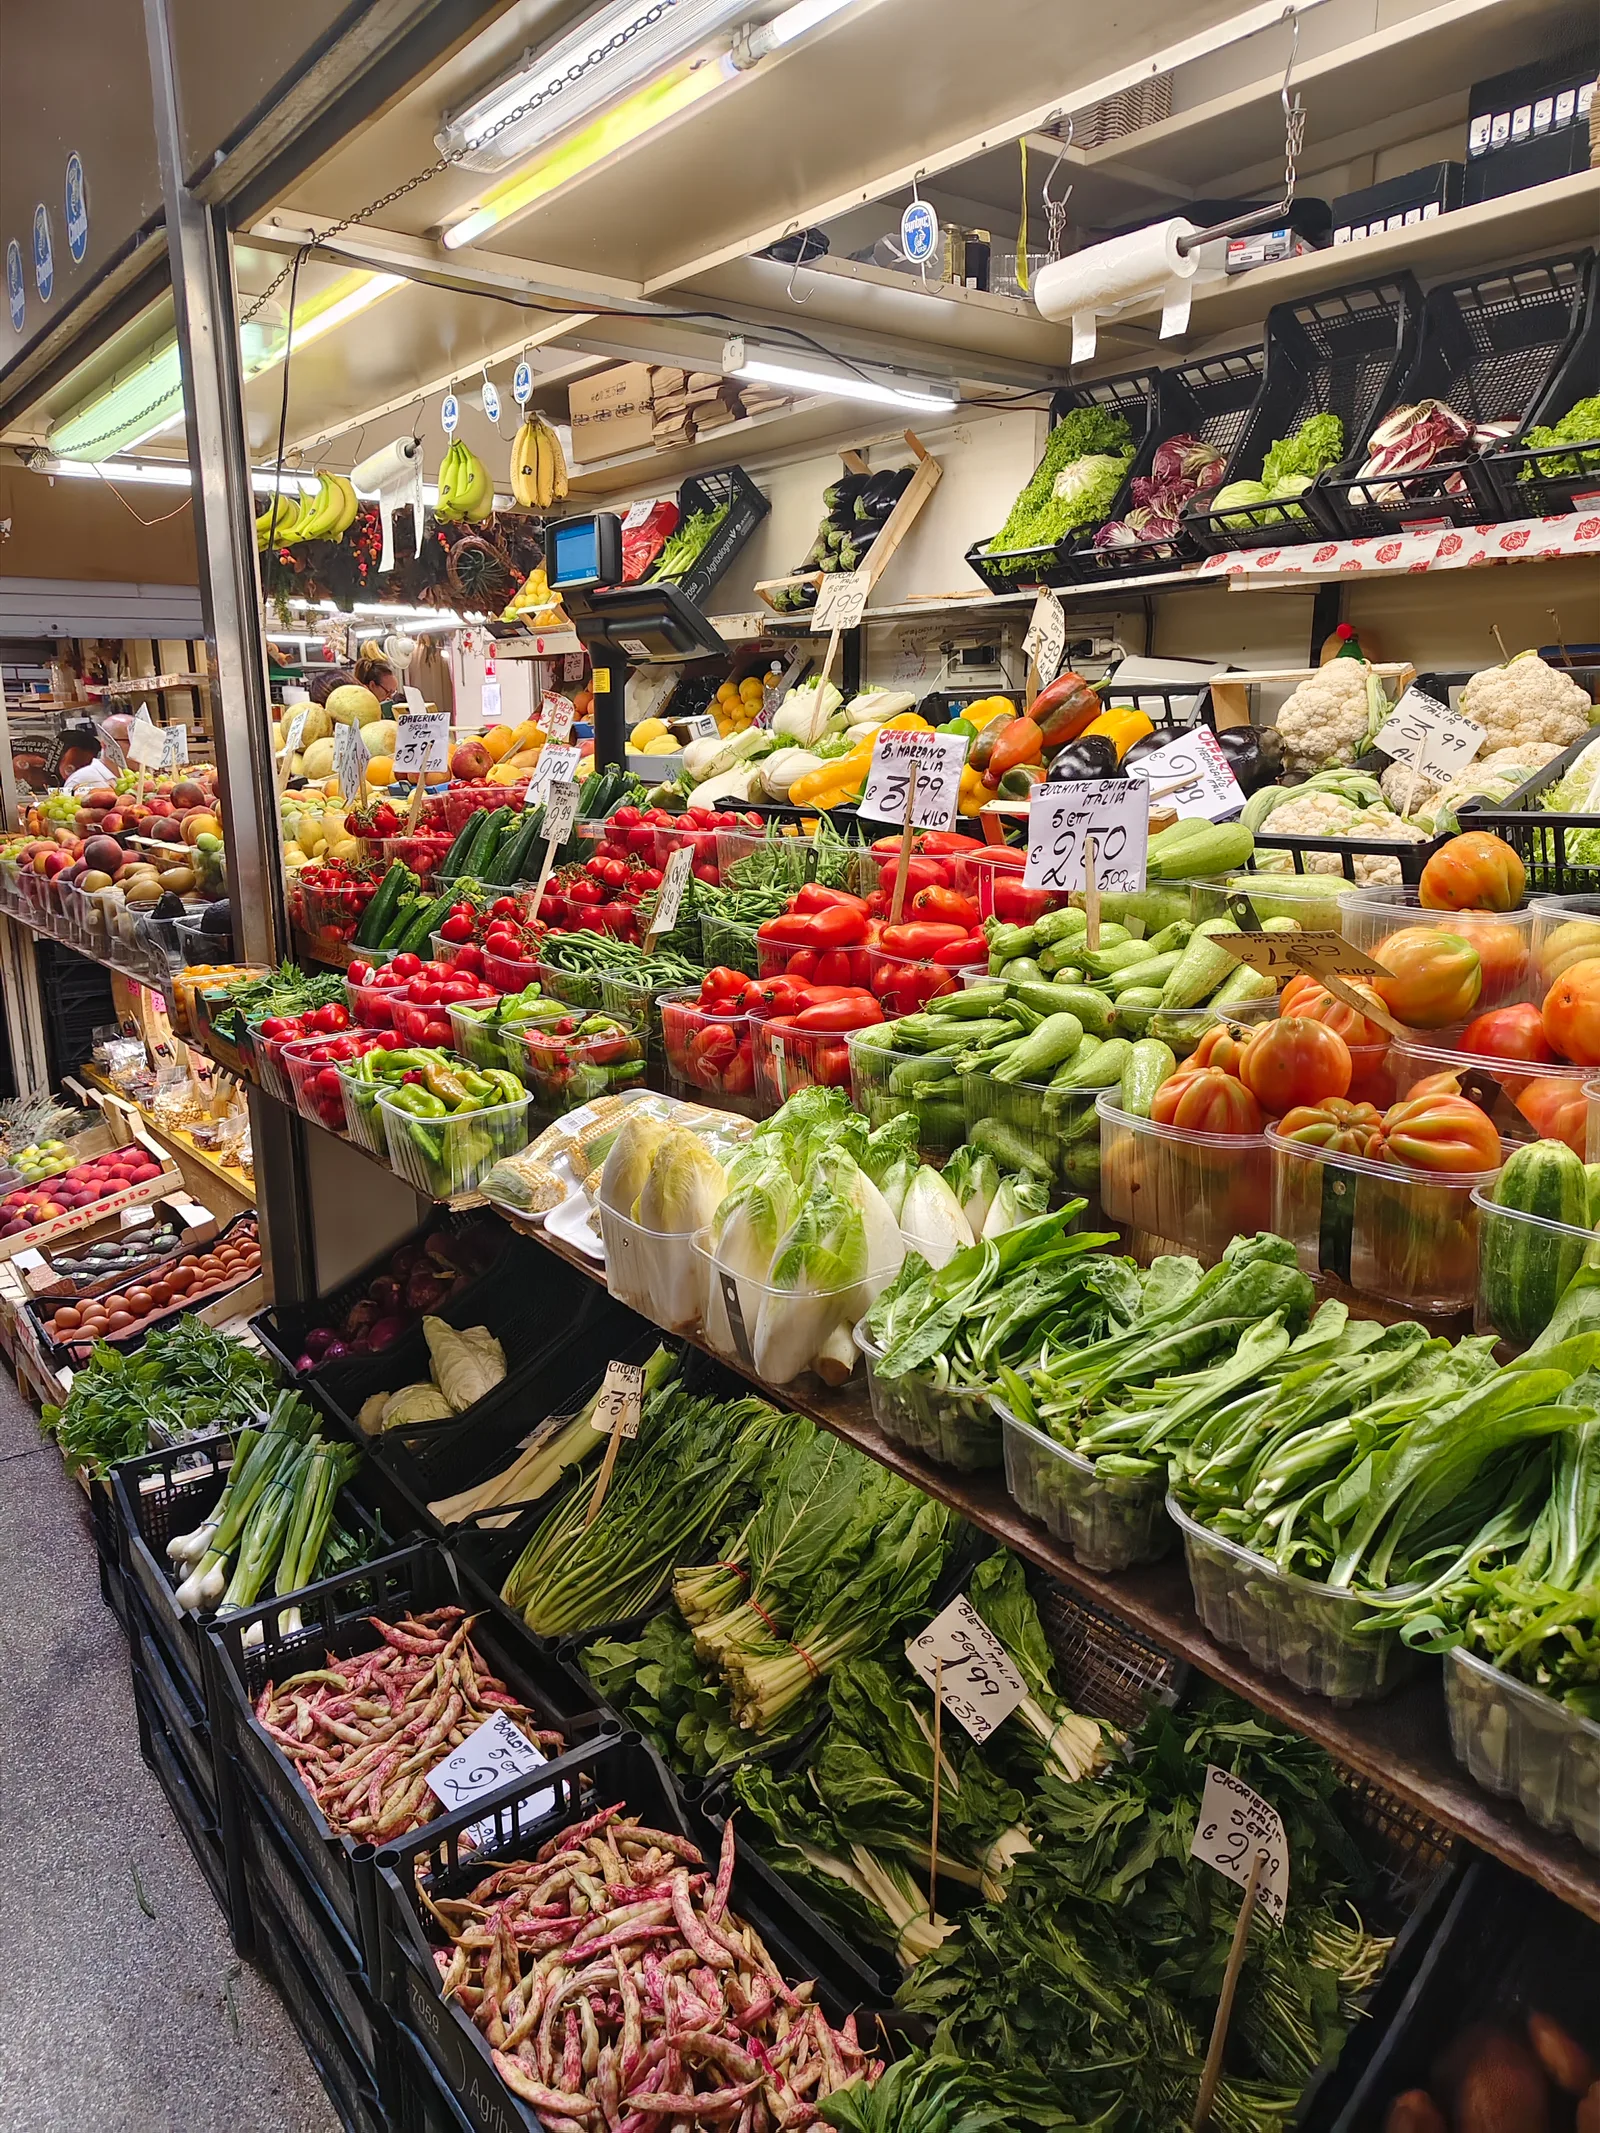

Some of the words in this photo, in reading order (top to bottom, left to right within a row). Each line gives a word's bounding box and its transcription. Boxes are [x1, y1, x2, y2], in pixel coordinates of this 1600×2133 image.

[905, 214, 931, 233] Chiquita
[706, 536, 735, 576] Agribologna
[1420, 704, 1456, 726] ITALIA
[879, 729, 935, 744] OFFERTA
[896, 745, 947, 759] MARZANO
[1197, 730, 1237, 785] OFFERTA
[1391, 748, 1415, 762] AL
[1422, 761, 1453, 783] KILO
[1040, 783, 1093, 797] ZUCCHINE
[1082, 791, 1126, 807] ITALIA
[919, 808, 949, 827] KILO
[1052, 808, 1066, 829] 5
[1121, 879, 1137, 892] KG
[1333, 966, 1376, 975] KILO
[957, 1601, 1005, 1656] BIETOLA
[985, 1651, 1020, 1690] ITALIA
[493, 1715, 536, 1759] BORLOTTI
[500, 1760, 525, 1777] ETT
[1211, 1770, 1280, 1827] CICORIETTA
[1230, 1808, 1248, 1827] 5
[1246, 1806, 1282, 1844] ITALIA
[410, 1983, 440, 2035] 7059
